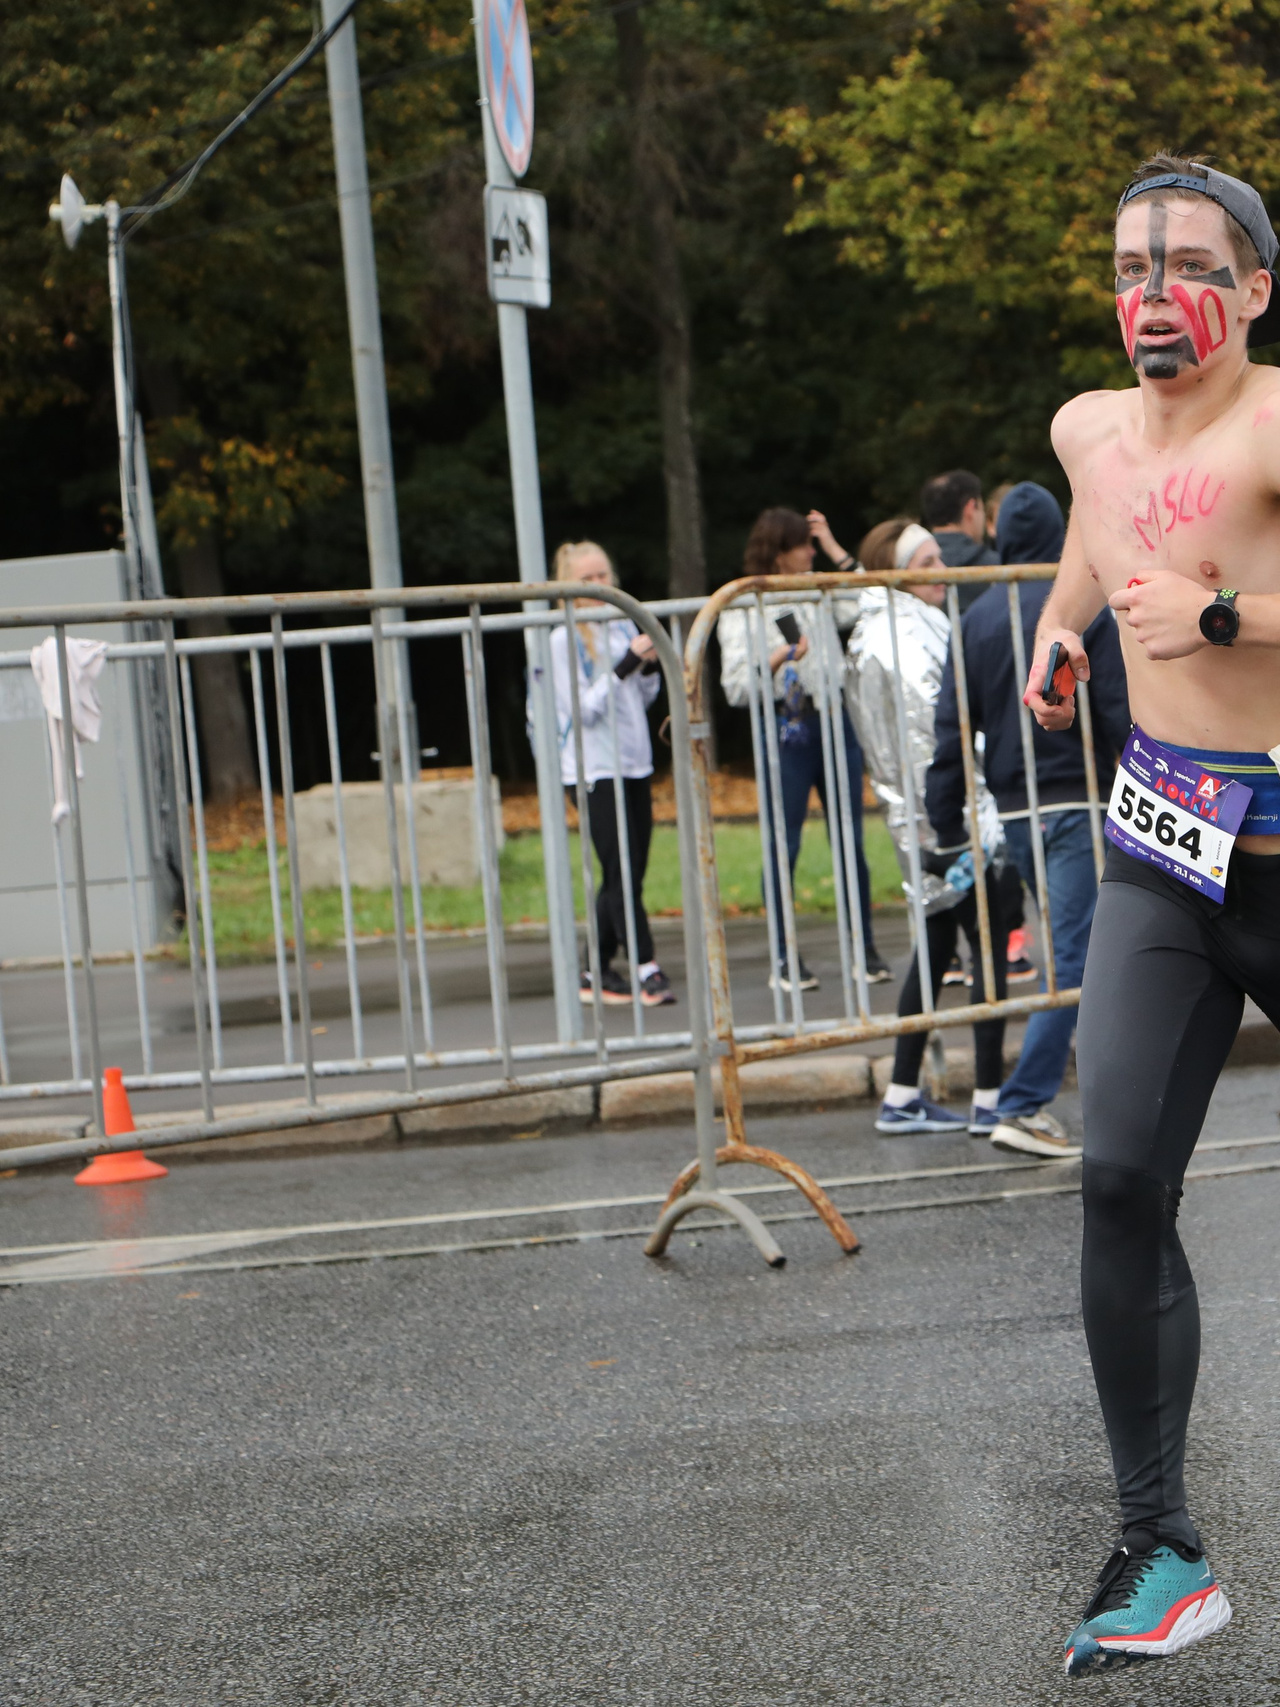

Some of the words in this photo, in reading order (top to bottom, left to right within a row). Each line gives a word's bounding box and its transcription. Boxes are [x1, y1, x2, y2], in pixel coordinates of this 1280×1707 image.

[1117, 783, 1202, 861] 5564
[1247, 813, 1279, 823] Kalenji
[1173, 864, 1189, 880] 21.1
